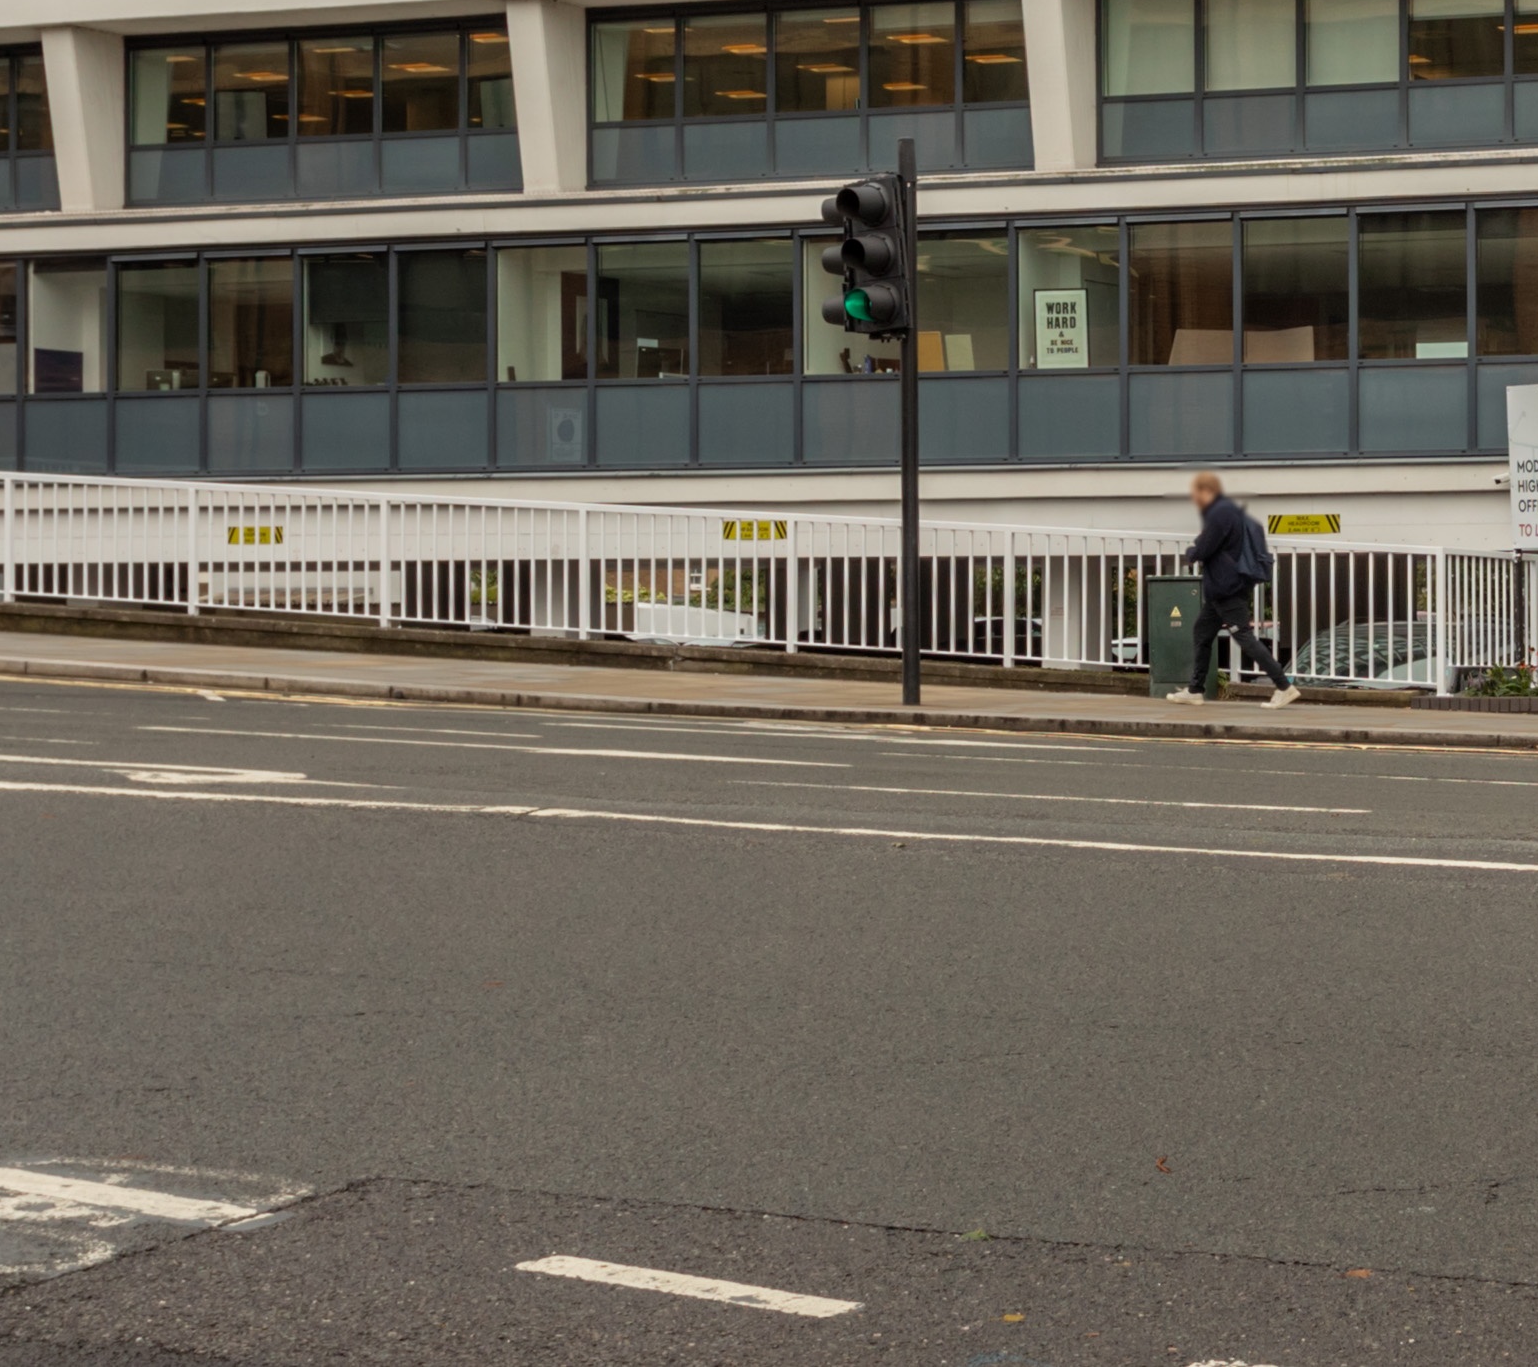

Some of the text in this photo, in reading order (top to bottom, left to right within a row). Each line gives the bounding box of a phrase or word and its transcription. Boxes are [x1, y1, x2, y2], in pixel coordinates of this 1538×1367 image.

[1045, 301, 1077, 315] WORK
[1046, 316, 1077, 329] HARD
[1058, 330, 1065, 338] &
[1518, 524, 1533, 537] TO
